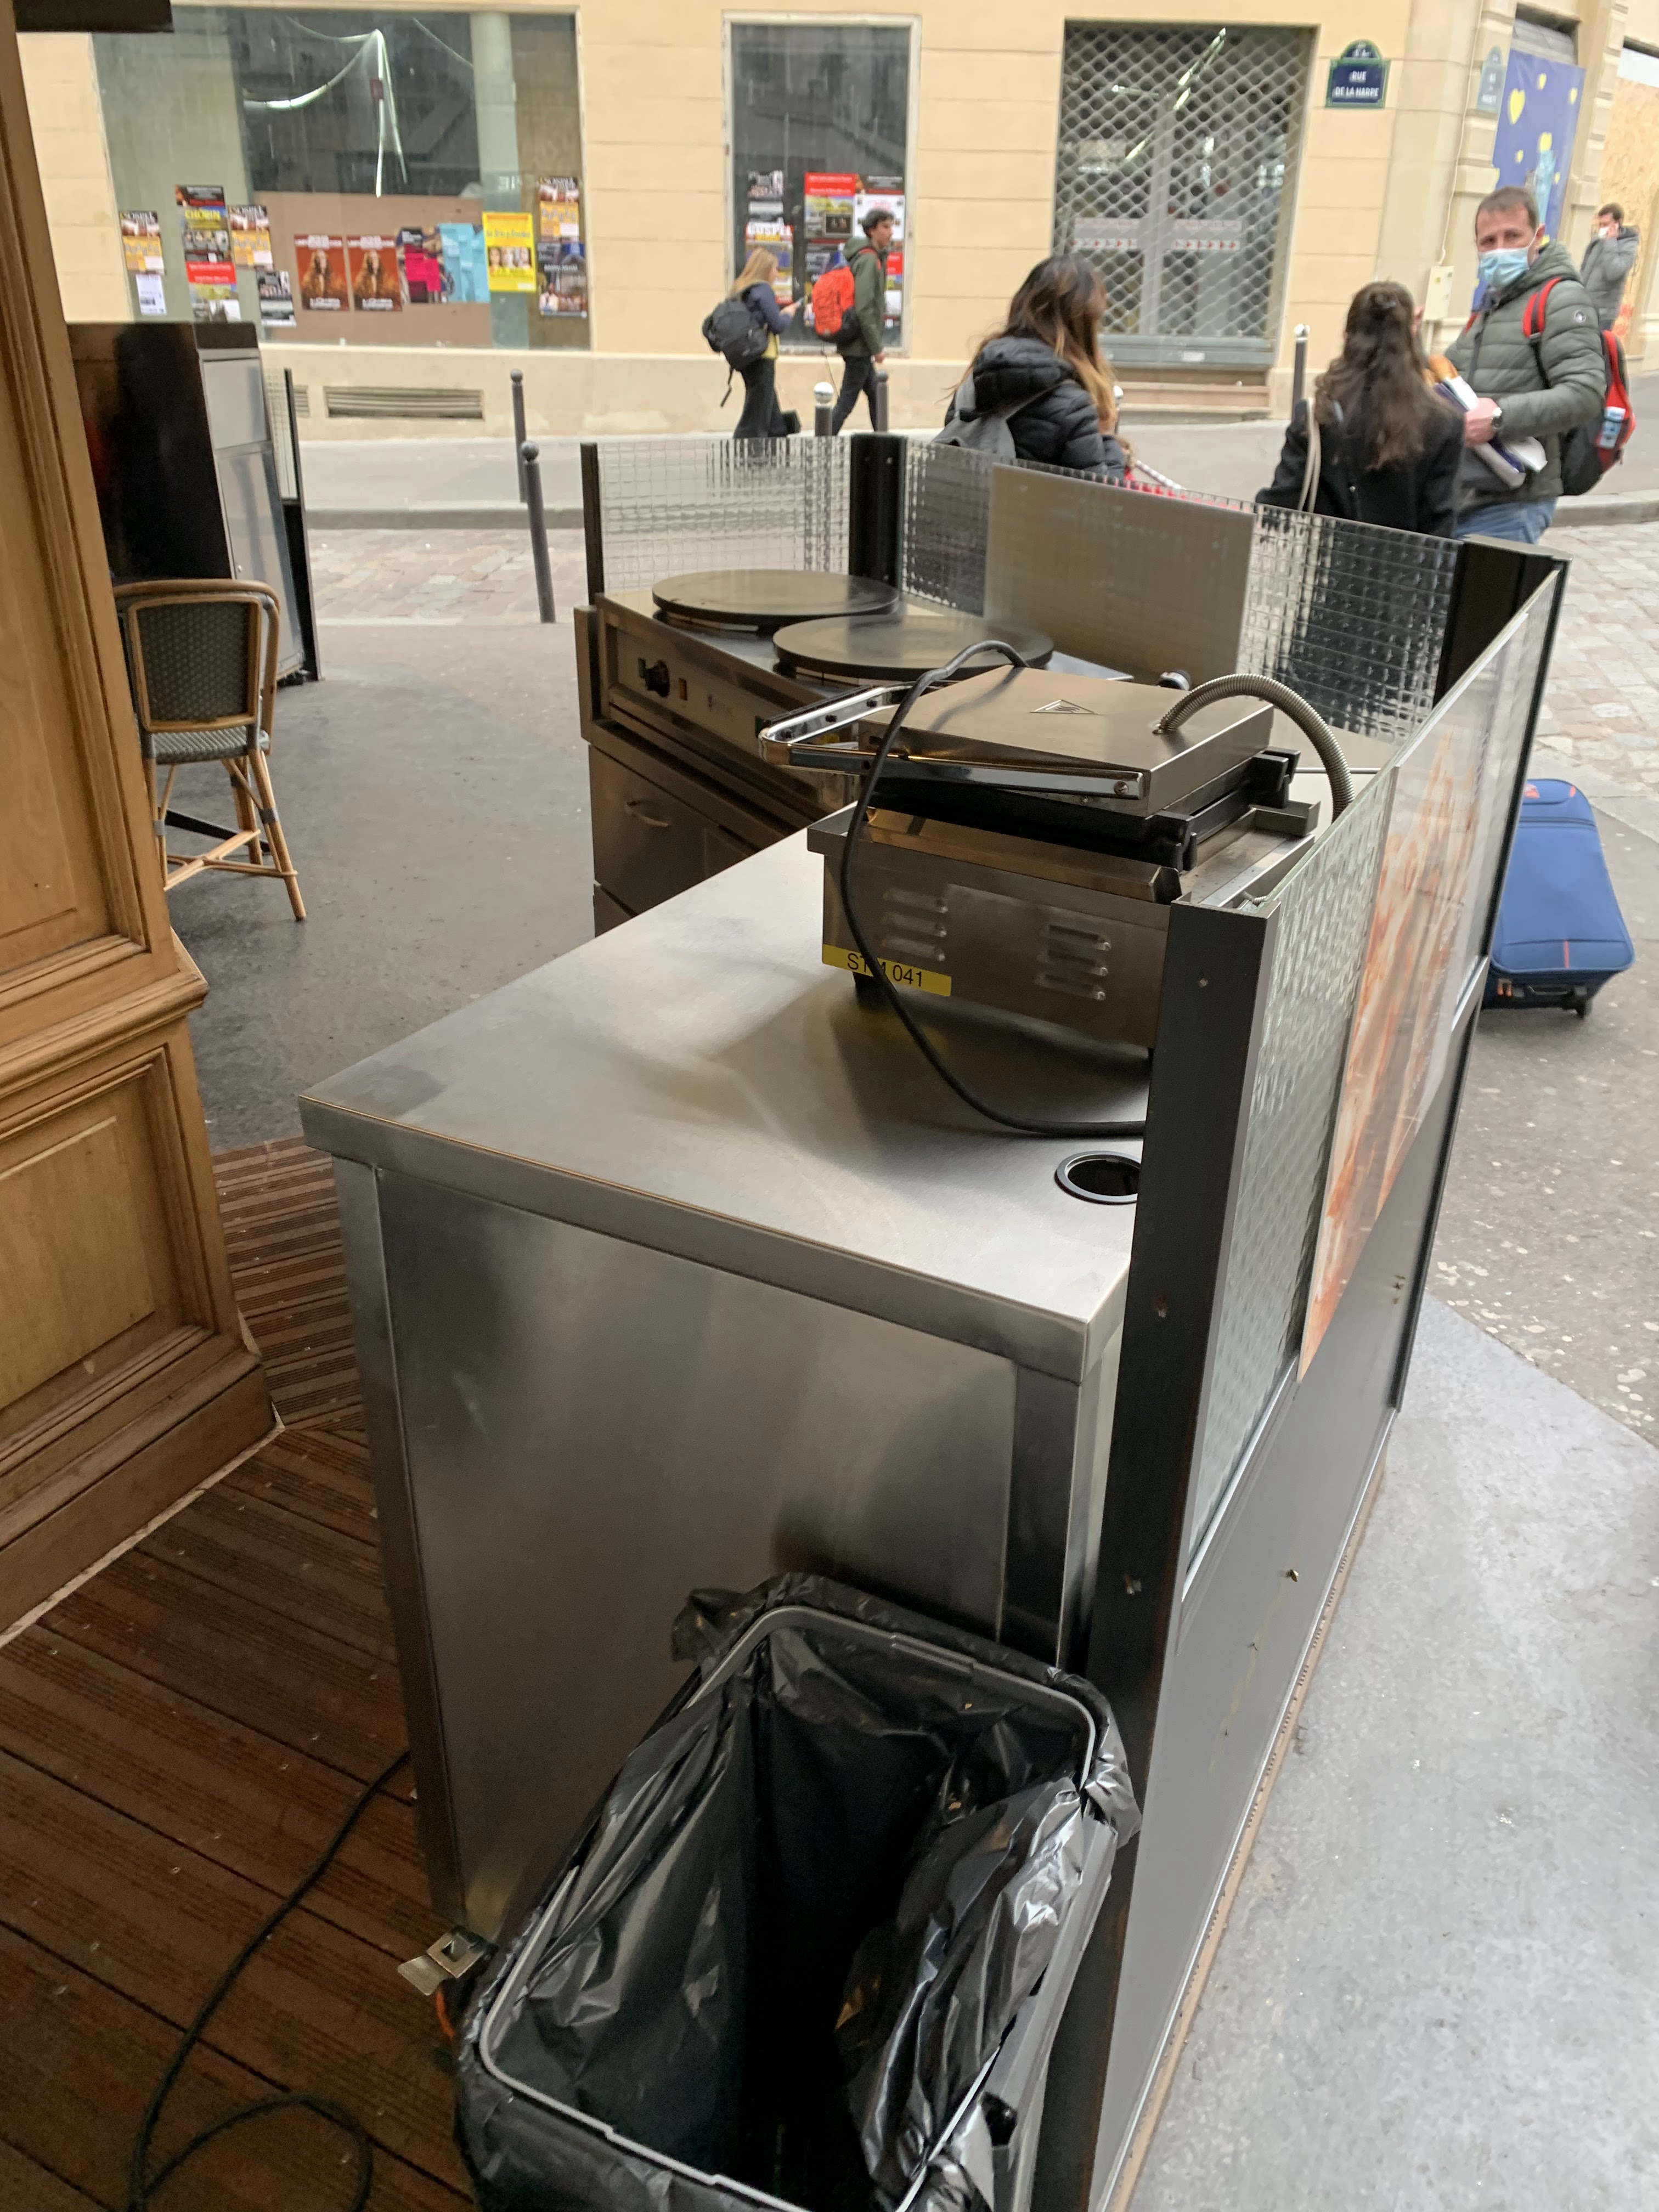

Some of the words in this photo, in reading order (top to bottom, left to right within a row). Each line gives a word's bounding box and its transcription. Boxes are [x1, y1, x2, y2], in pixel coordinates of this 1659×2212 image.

[1350, 71, 1367, 81] RUE
[1334, 86, 1345, 97] DE
[1345, 86, 1355, 97] LA
[1355, 87, 1380, 98] HARPE
[893, 964, 922, 988] 041
